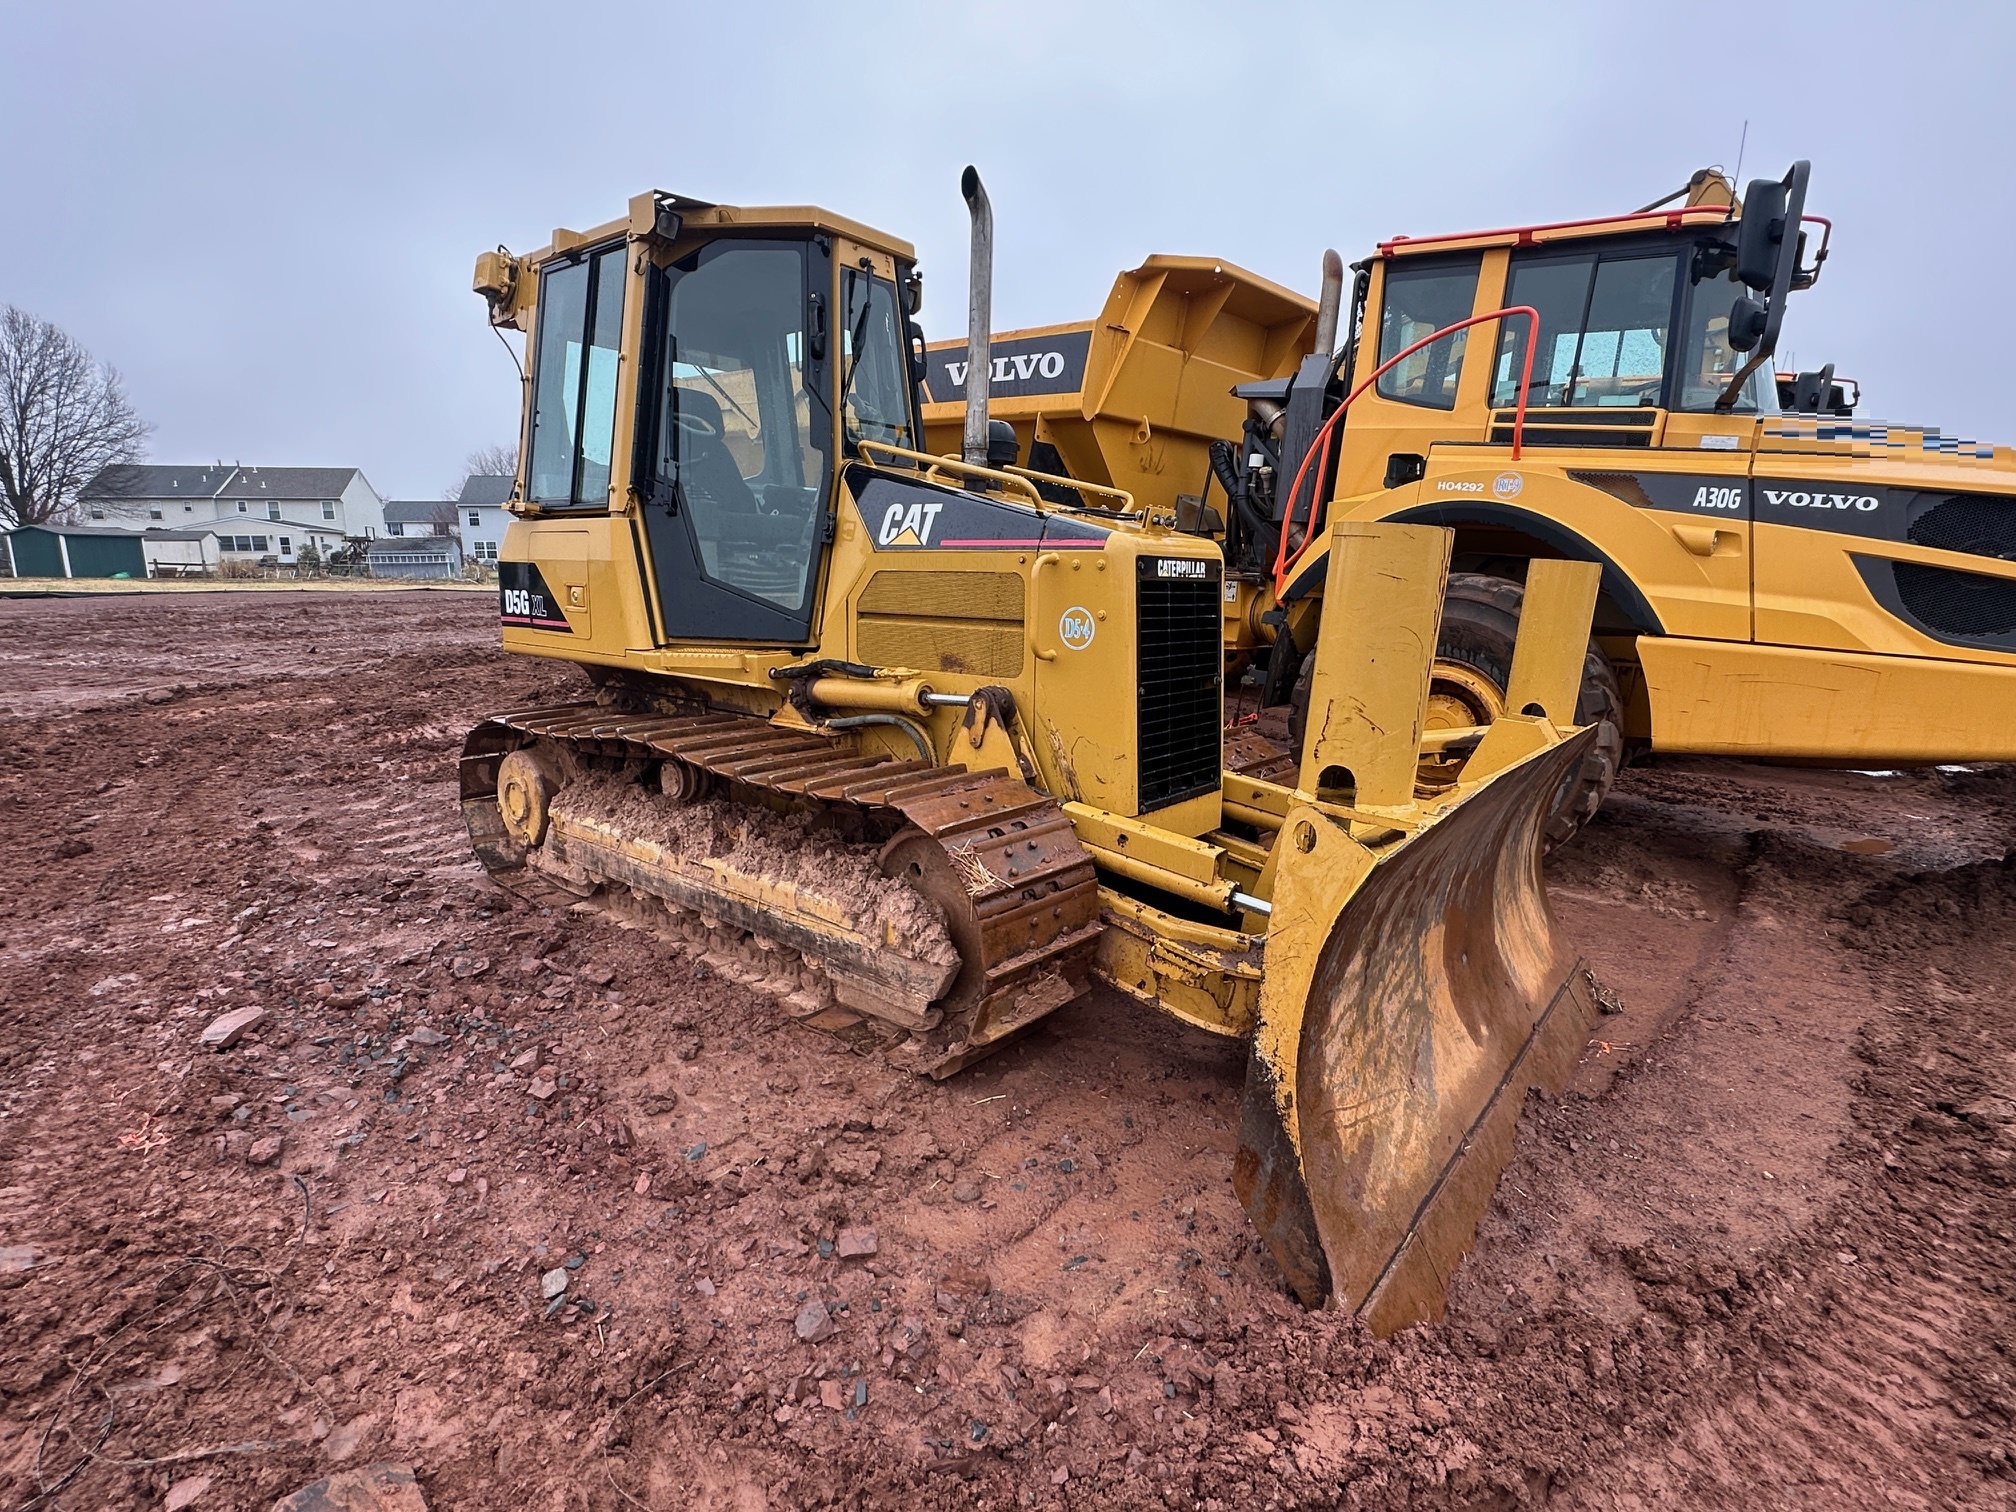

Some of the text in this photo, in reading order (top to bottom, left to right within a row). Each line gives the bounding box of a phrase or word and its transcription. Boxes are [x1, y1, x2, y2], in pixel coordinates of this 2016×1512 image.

[945, 352, 1065, 386] VLVO
[1693, 487, 1742, 509] A30G
[1763, 490, 1879, 511] VOLVO
[879, 503, 943, 546] CAT
[1158, 559, 1206, 579] CATERPILLAR
[504, 589, 547, 617] D5G XL
